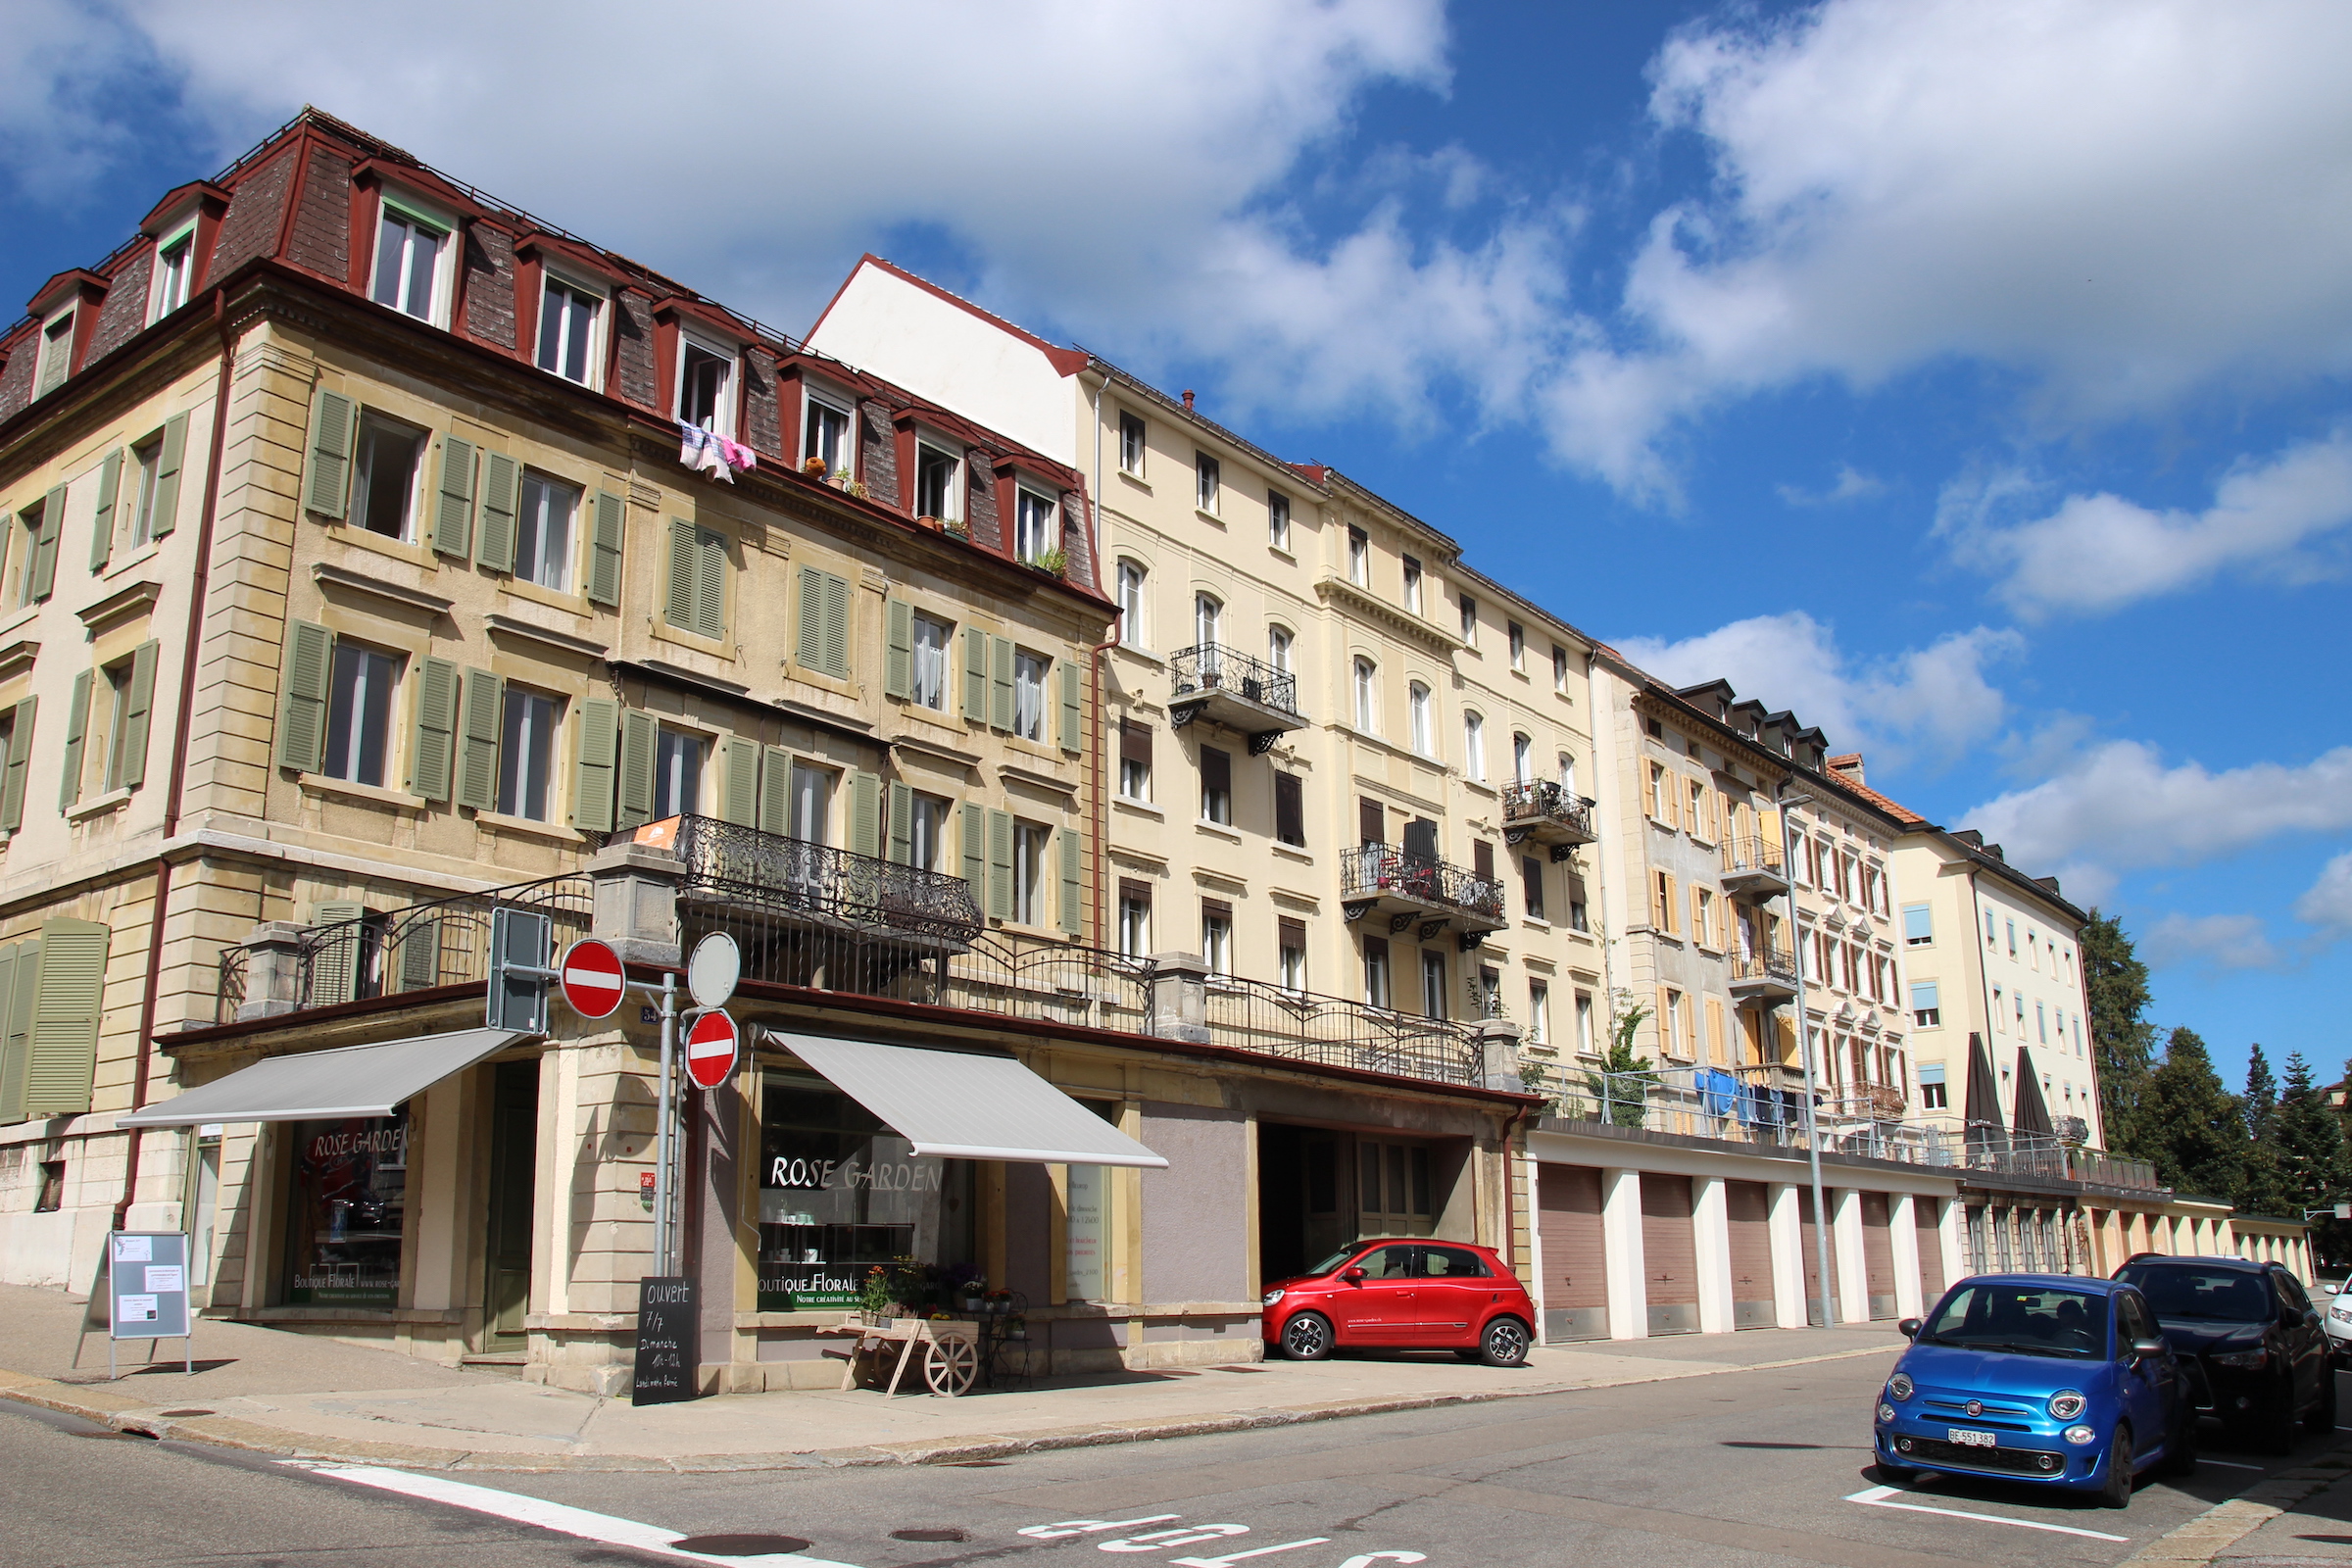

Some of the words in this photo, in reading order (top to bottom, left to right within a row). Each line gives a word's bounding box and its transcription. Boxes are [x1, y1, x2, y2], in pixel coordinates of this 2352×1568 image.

[315, 1133, 349, 1156] ROSE
[771, 1155, 835, 1189] ROSE
[844, 1161, 943, 1192] GARDEN
[757, 1276, 808, 1295] OUTIQUE
